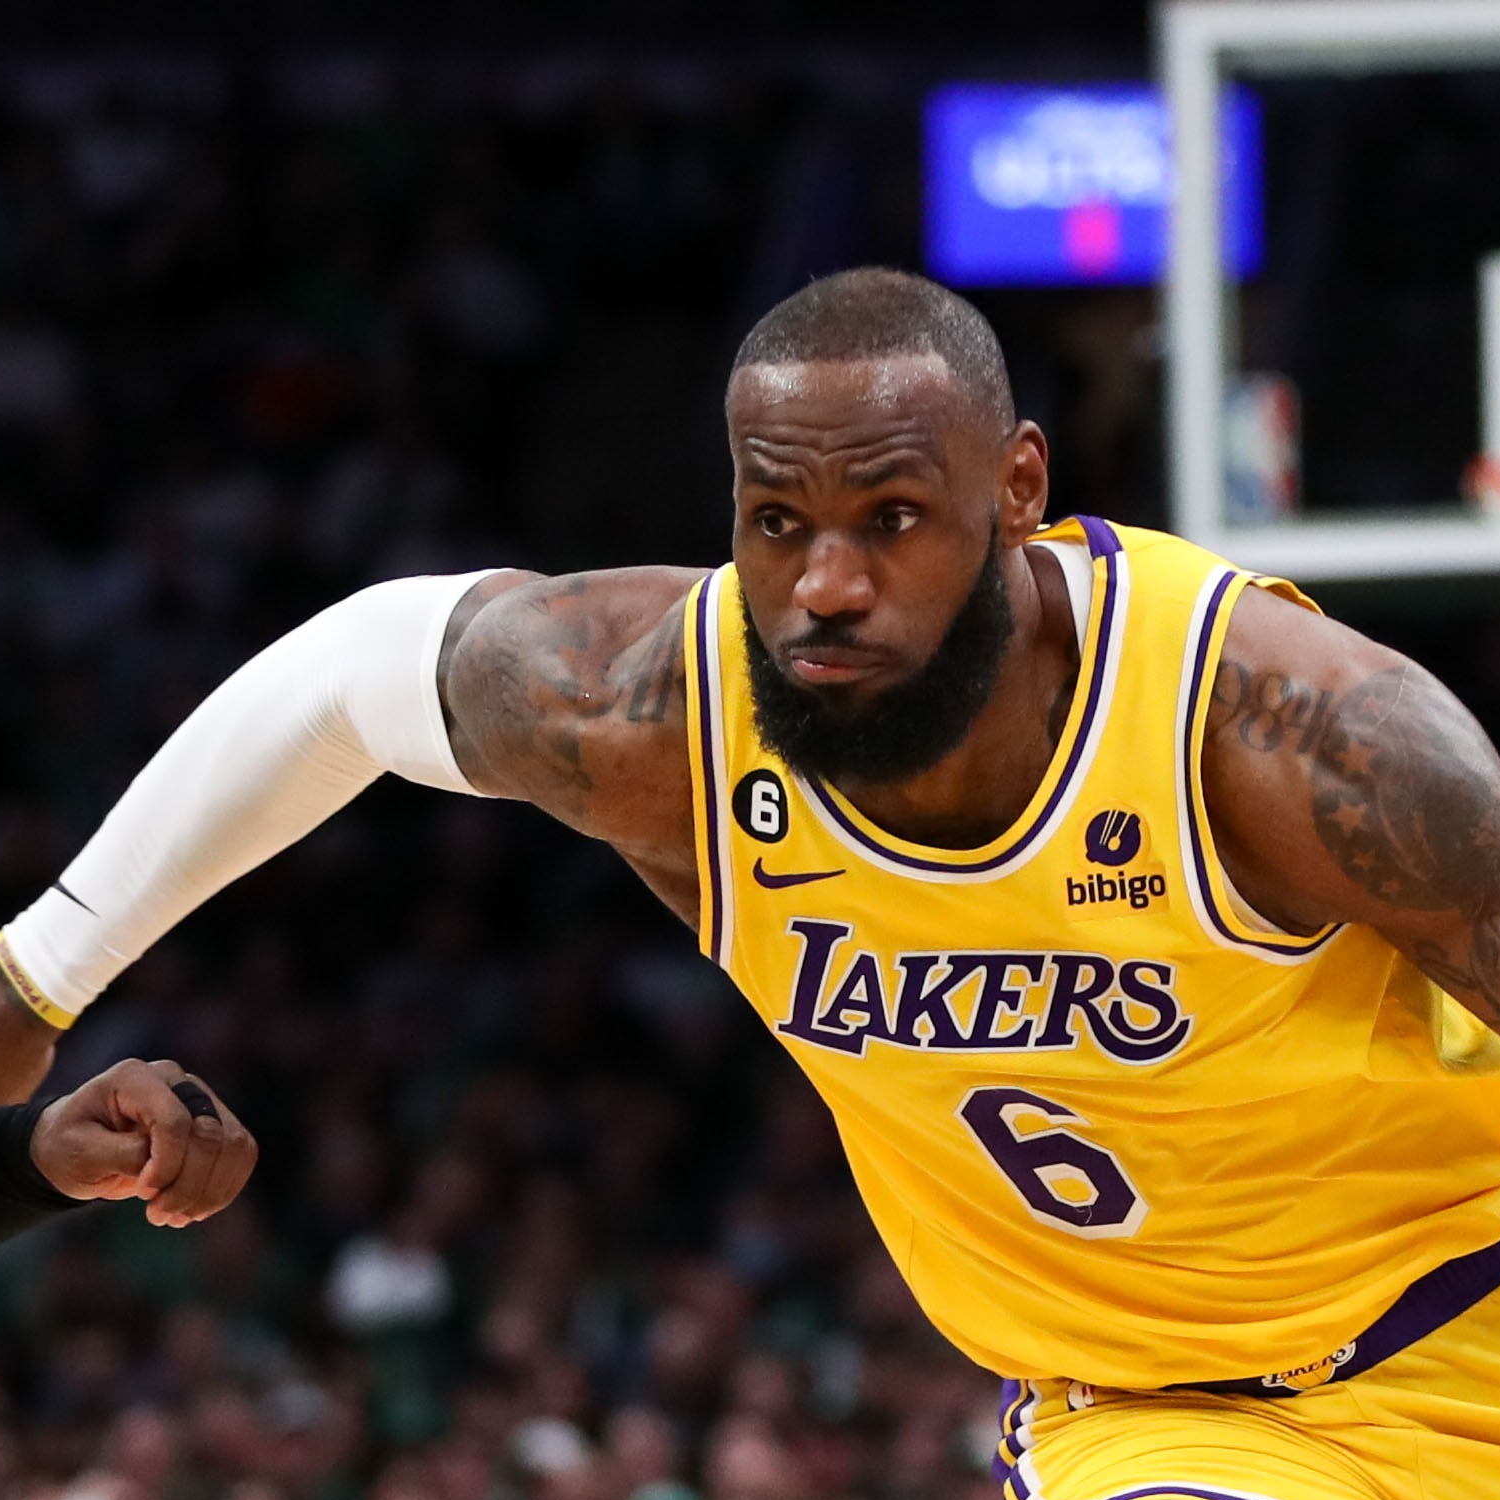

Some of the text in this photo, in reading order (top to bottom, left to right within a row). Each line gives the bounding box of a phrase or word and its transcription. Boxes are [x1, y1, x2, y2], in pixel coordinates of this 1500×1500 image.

[751, 780, 780, 834] 6
[1066, 872, 1166, 909] bibigo
[774, 917, 1194, 1066] LAKERS
[954, 1085, 1149, 1240] 6
